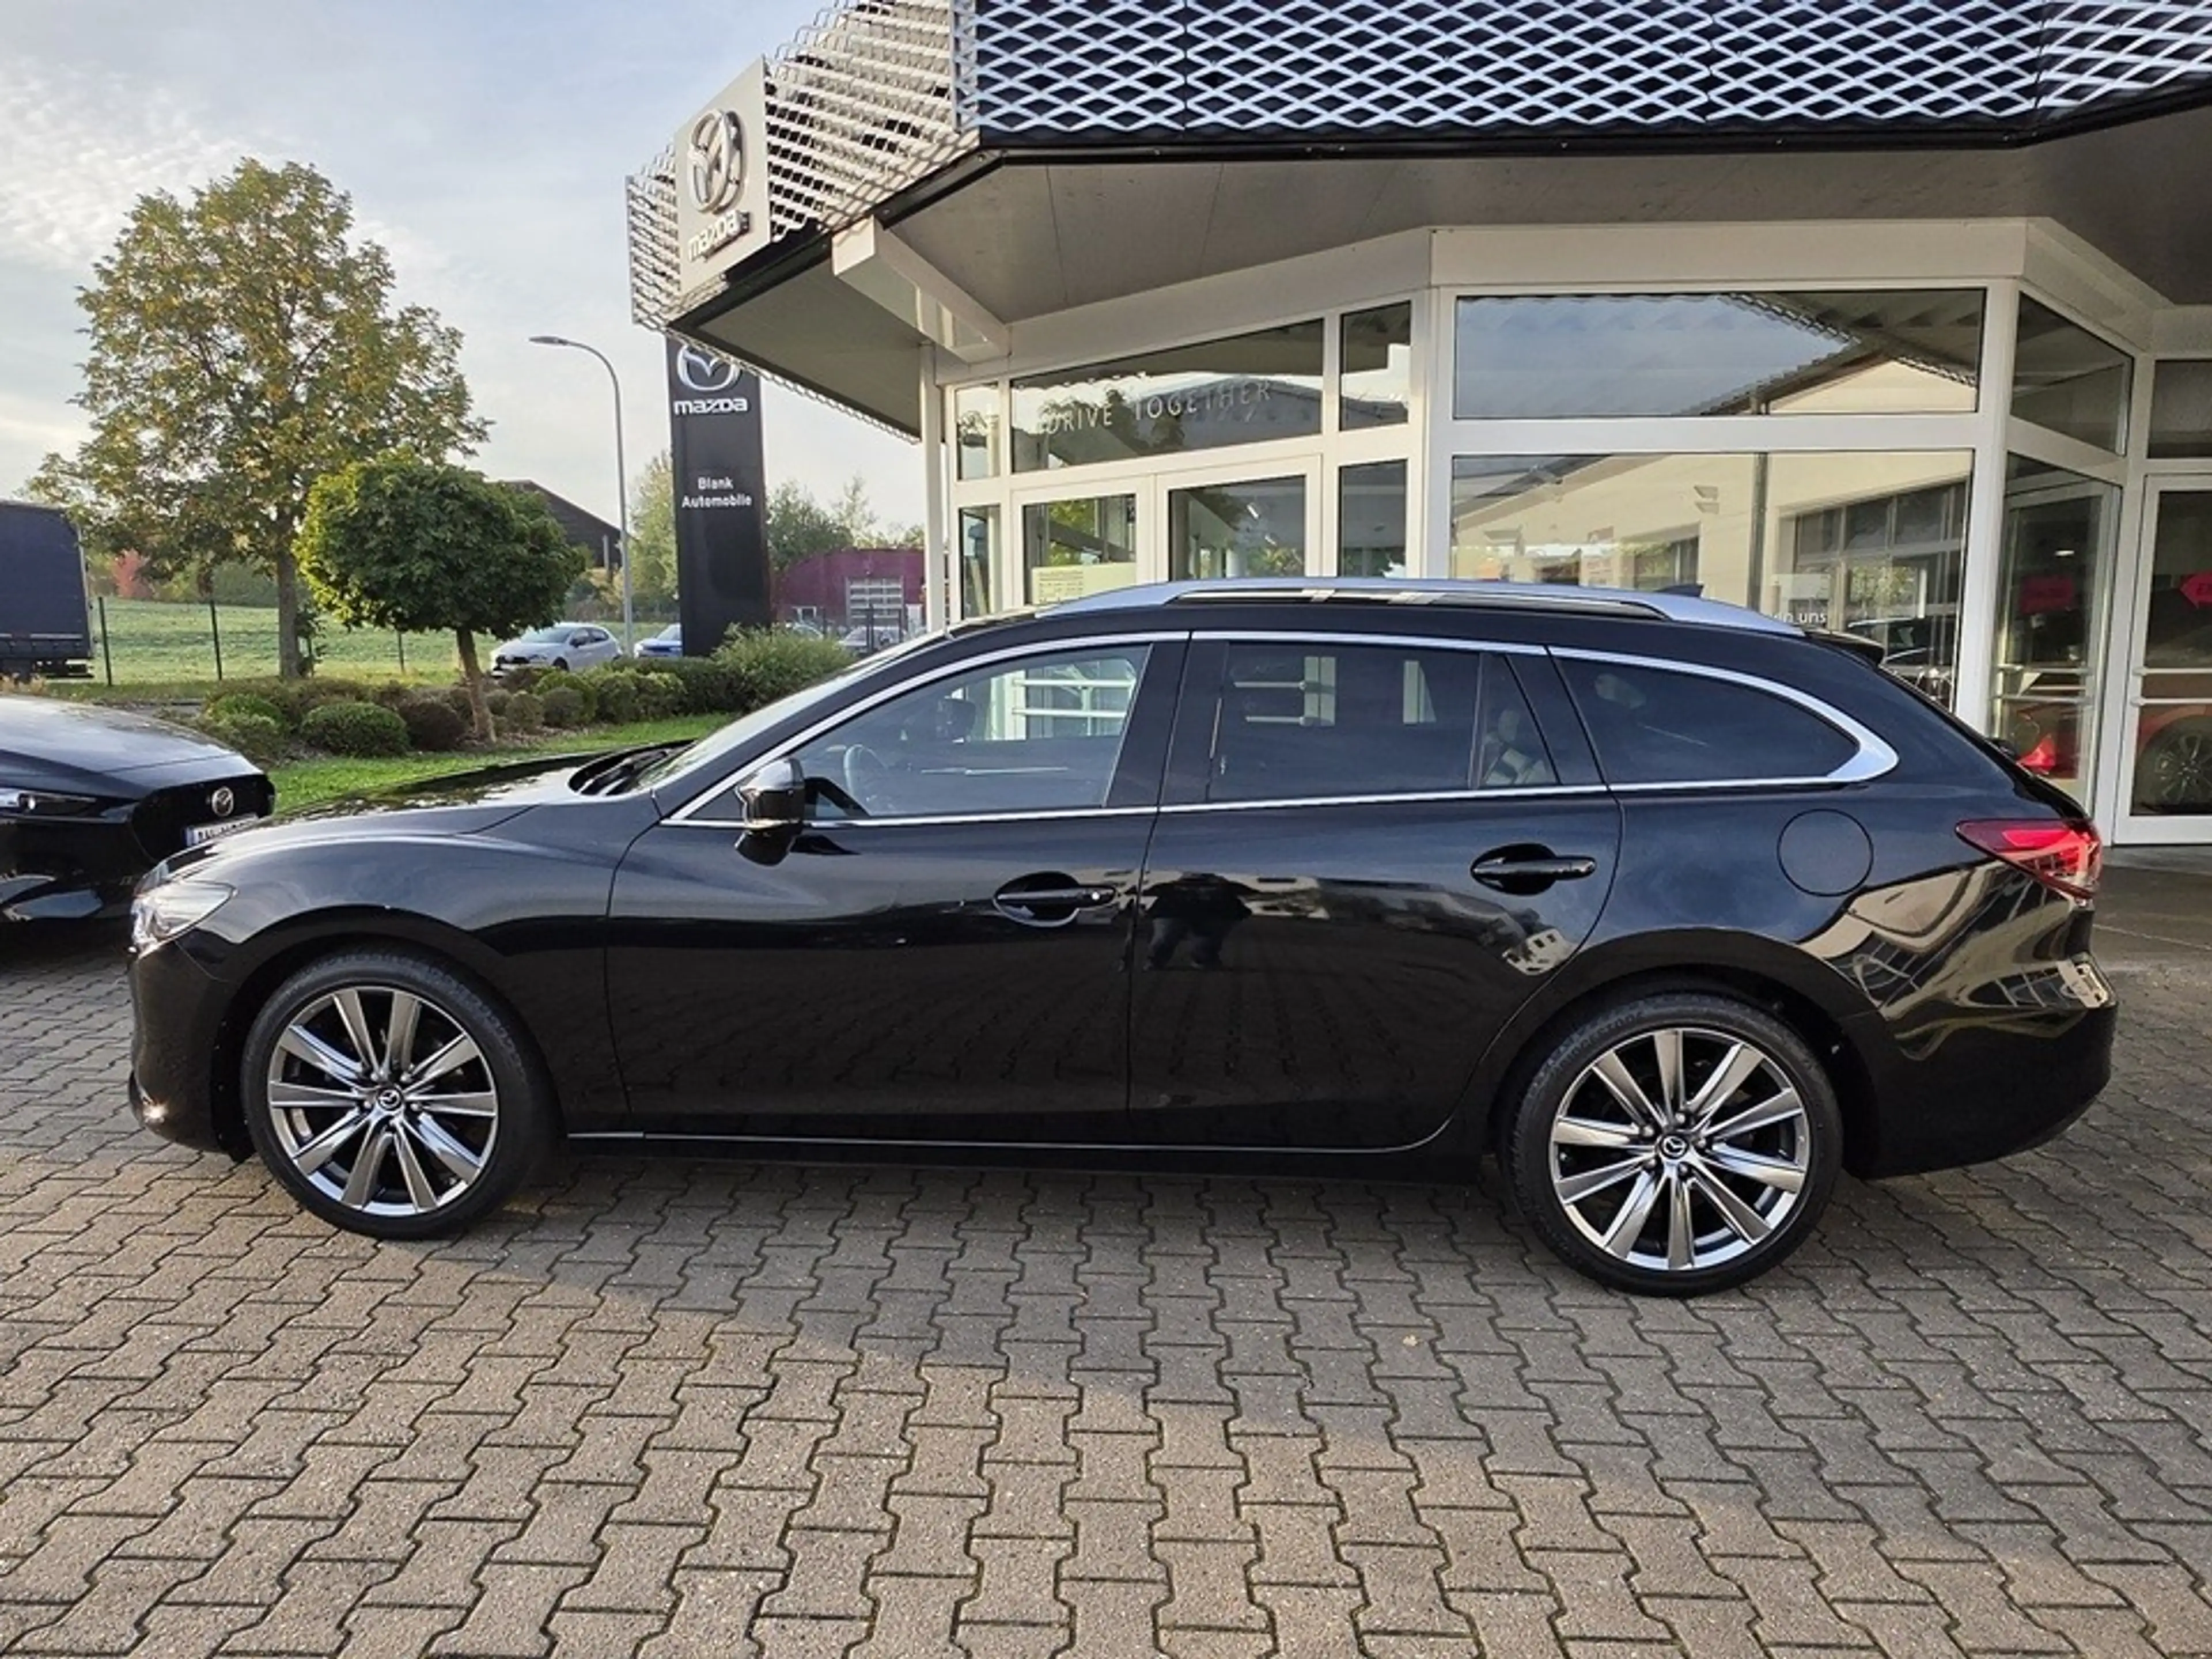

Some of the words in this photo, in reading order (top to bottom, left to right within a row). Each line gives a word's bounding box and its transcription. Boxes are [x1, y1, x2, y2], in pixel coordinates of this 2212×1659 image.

[688, 209, 740, 262] mazda
[673, 397, 748, 415] mazda
[1047, 404, 1112, 435] DRIVE
[1132, 381, 1271, 421] TOGETHER
[698, 477, 733, 490] Blank
[681, 494, 752, 508] Automobile
[1799, 612, 1827, 623] uns
